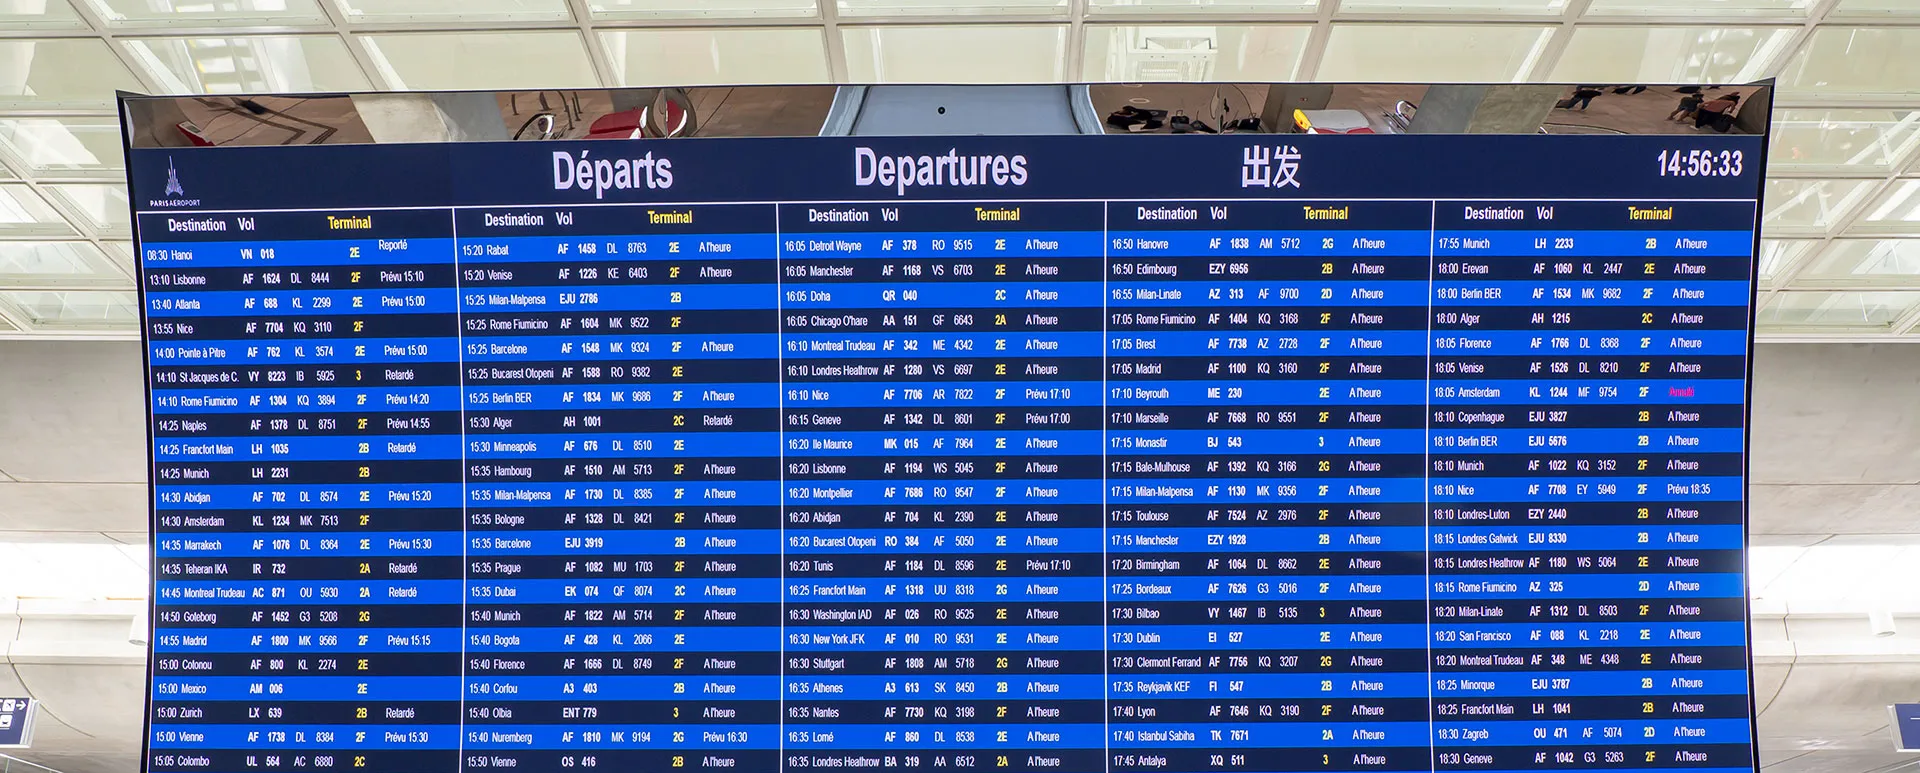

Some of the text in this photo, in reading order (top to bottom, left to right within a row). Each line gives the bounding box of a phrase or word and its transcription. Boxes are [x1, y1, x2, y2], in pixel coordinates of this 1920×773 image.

[1242, 145, 1301, 188] 出发
[1658, 150, 1742, 176] 14:56:33
[553, 150, 673, 199] Départs
[856, 147, 1027, 195] Departures
[485, 210, 692, 226] Destination Vol Terminal
[809, 208, 1020, 222] Destination Vol Terminal
[1138, 206, 1348, 220] Destination Vol Terminal
[1465, 206, 1672, 220] Destination Vol Terminal
[168, 216, 371, 231] Destination Vol Terminal
[147, 239, 408, 260] 08:30 Hanoi VN 018 2E Reporté
[786, 241, 808, 251] 16:05
[809, 241, 834, 251] Detroit
[836, 240, 861, 253] Wayne
[882, 240, 893, 250] AF
[903, 240, 917, 250] 378
[932, 240, 945, 250] RO
[954, 240, 972, 250] 9515
[995, 239, 1005, 250] 2E
[464, 270, 484, 280] 15:20
[487, 270, 512, 280] Venise
[559, 269, 570, 279] AF
[579, 268, 597, 279] 1226
[608, 268, 619, 278] KE
[629, 267, 647, 278] 6403
[670, 267, 680, 278] 2F
[1113, 264, 1133, 274] 16:50
[1137, 264, 1177, 276] Edimbourg
[1209, 263, 1226, 274] EZY
[1230, 263, 1248, 274] 6956
[1322, 263, 1333, 274] 2B
[466, 292, 681, 306] 15:25 Milan-Malpensa EJU 2786 2B
[1437, 313, 1457, 323] 18:00
[1460, 313, 1480, 326] Alger
[1532, 313, 1544, 323] AH
[1552, 313, 1570, 323] 1215
[1642, 313, 1653, 323] 2C
[470, 415, 733, 429] 15:30 Alger AH 1001 2C Retardé
[789, 413, 1070, 425] 16:15 Geneve AF 1342 DL 8601 2F Prévu 17:00
[161, 467, 370, 478] 14:25 Munich LH 2231 2B
[1434, 484, 1710, 495] 18:10 Nice AF 7708 EY 5949 2F Prévu 18:35
[1112, 608, 1133, 618] 17:30
[1137, 608, 1160, 618] Bilbao
[1208, 608, 1219, 618] VY
[1229, 608, 1247, 618] 1467
[1258, 607, 1266, 618] IB
[1279, 607, 1297, 618] 5135
[1320, 607, 1325, 617] 3
[159, 683, 367, 694] 15:00 Mexico AM 006 2E
[789, 683, 809, 693] 16:35
[813, 683, 843, 693] Athenes
[885, 683, 896, 692] A3
[905, 683, 919, 692] 613
[935, 682, 946, 692] SK
[956, 682, 974, 692] 8450
[997, 682, 1008, 692] 2B
[1437, 680, 1457, 690] 18:25
[1461, 680, 1495, 691] Minorque
[1532, 679, 1548, 689] EJU
[1552, 679, 1570, 689] 3787
[1642, 678, 1652, 688] 2B
[157, 732, 428, 742] 15:00 Vienne AF 1738 DL 8384 2F Prévu 15:30
[468, 756, 487, 767] 15:50
[491, 756, 516, 767] Vienne
[562, 756, 574, 767] OS
[582, 756, 596, 767] 416
[673, 756, 683, 767] 2B
[1114, 755, 1134, 766] 17:45
[1138, 756, 1166, 768] Antalya
[1211, 755, 1223, 766] XQ
[1231, 755, 1244, 765] 511
[1323, 754, 1328, 764] 3
